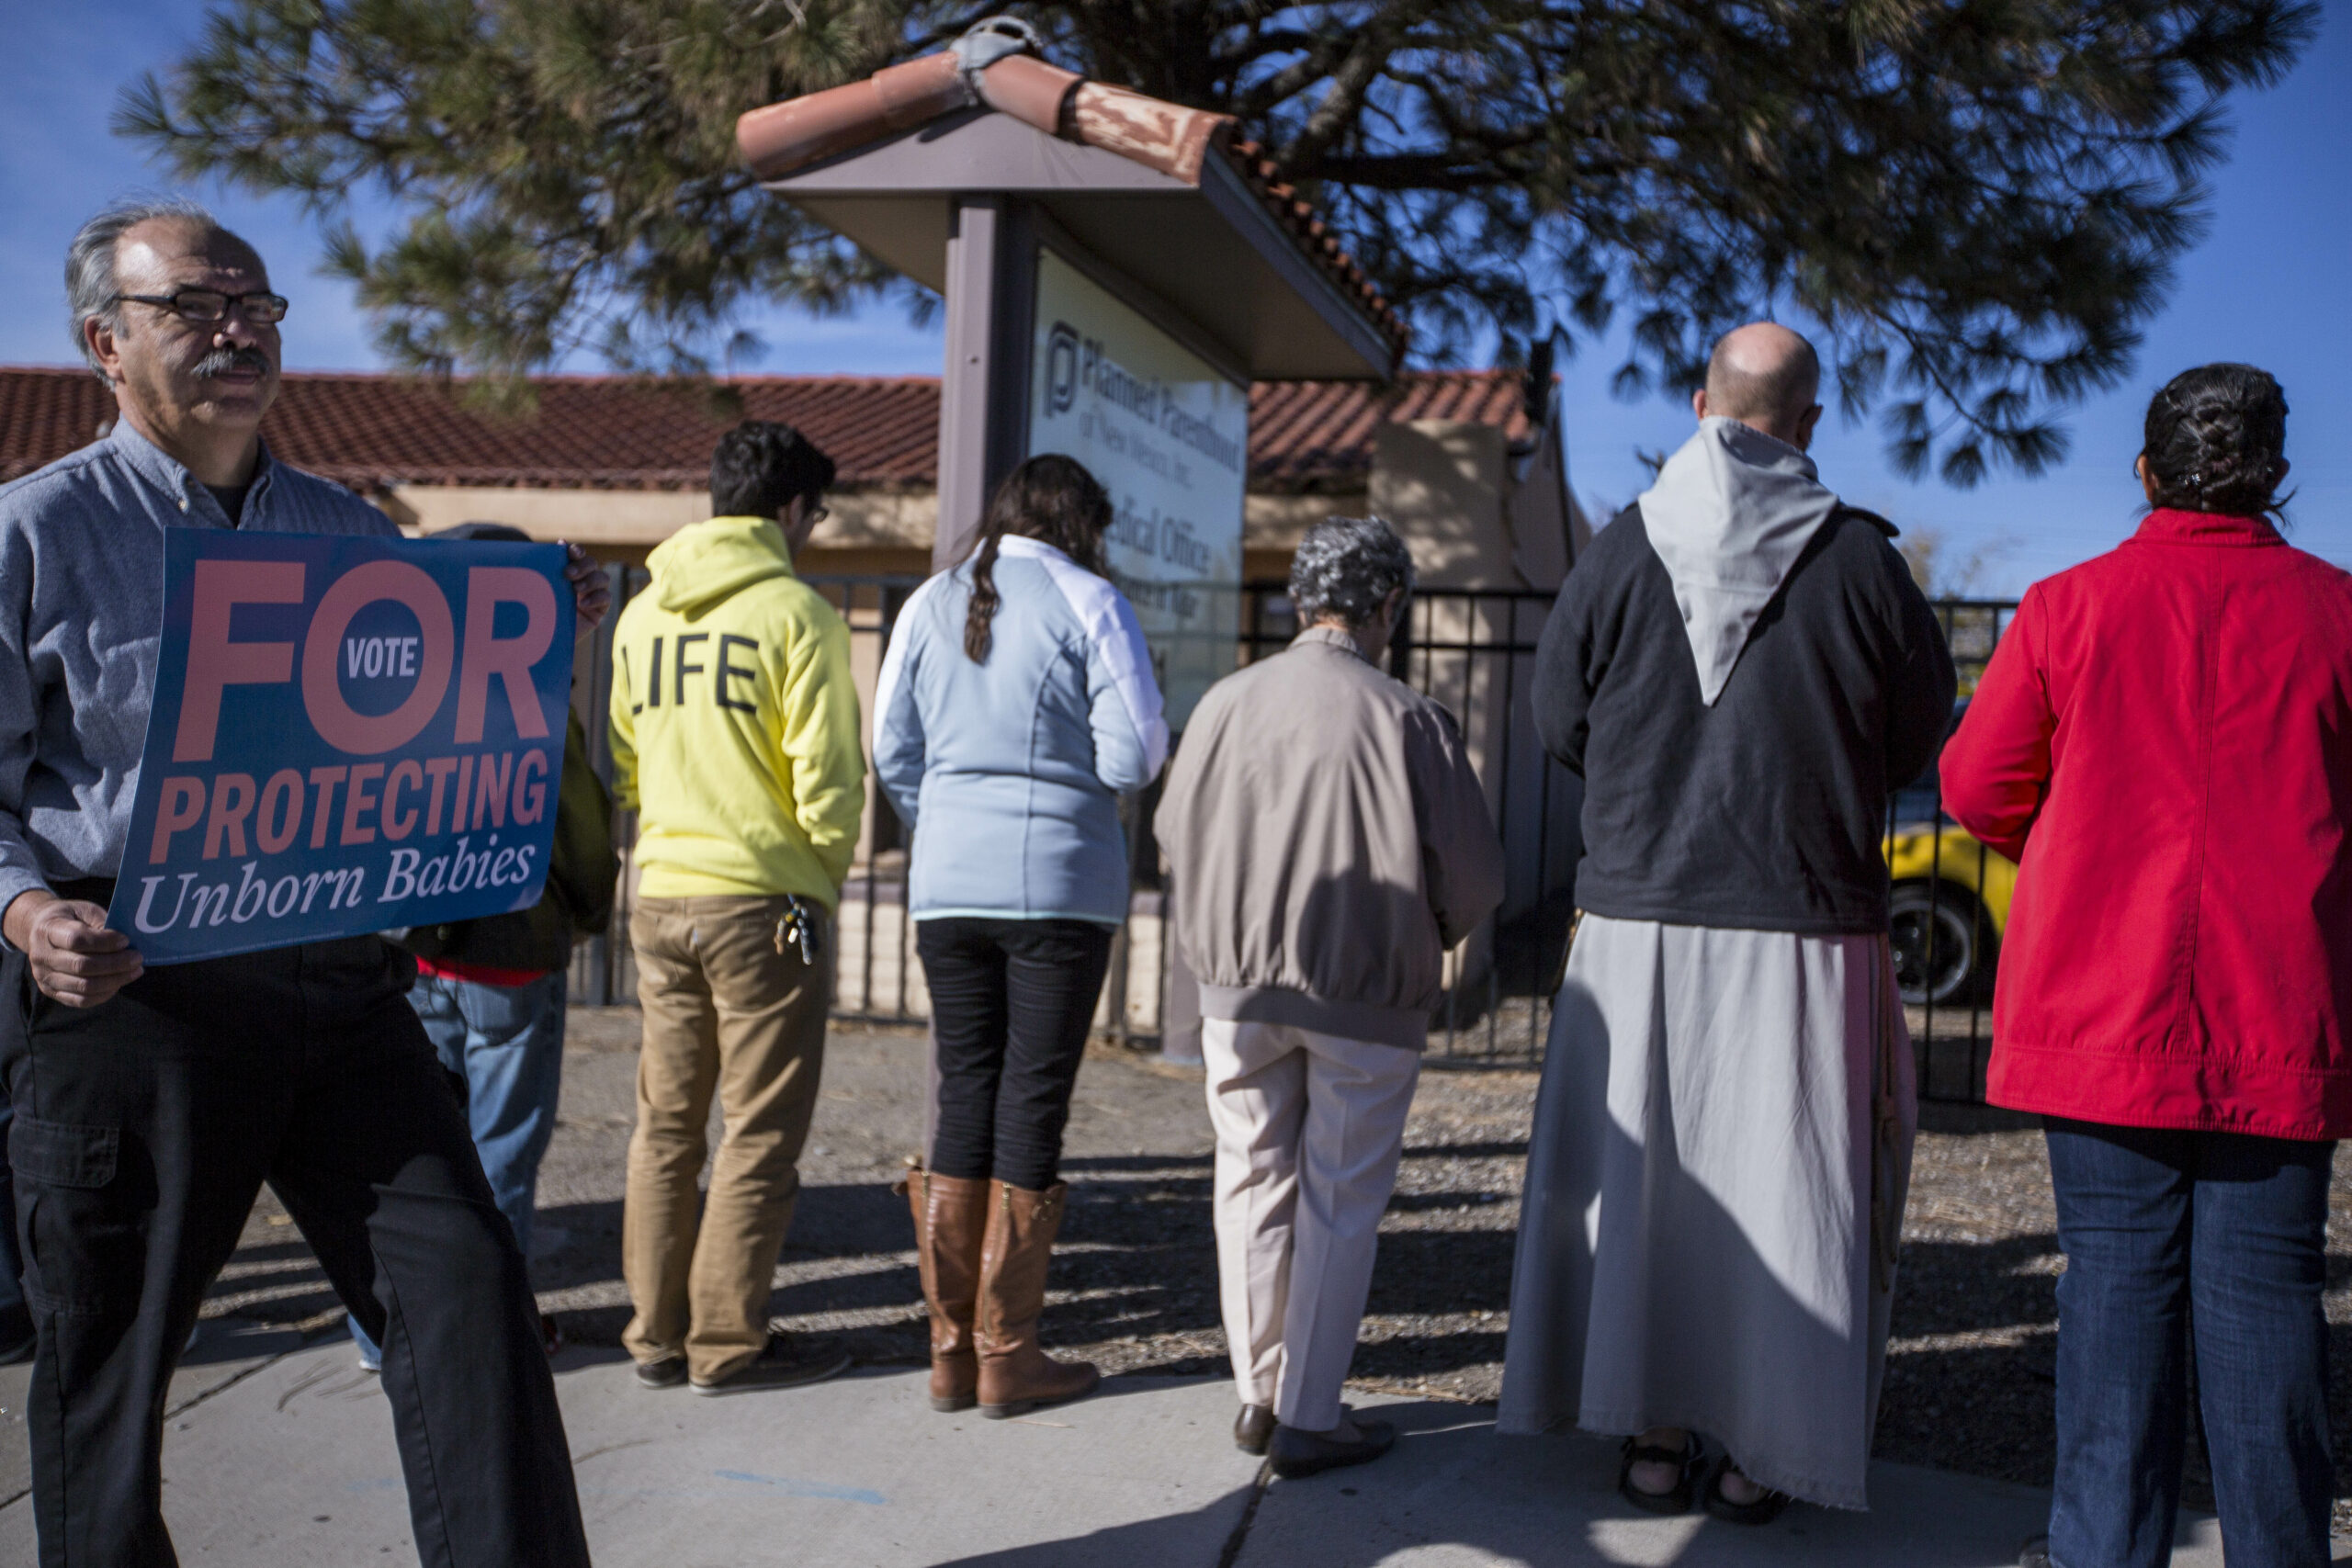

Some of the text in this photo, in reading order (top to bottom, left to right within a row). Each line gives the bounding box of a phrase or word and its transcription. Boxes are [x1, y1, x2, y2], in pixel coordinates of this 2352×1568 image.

[1081, 337, 1160, 424] Planned
[1103, 494, 1209, 575] edical Office
[172, 558, 557, 763] FOR
[346, 637, 418, 679] VOTE
[148, 749, 550, 864] PROTECTING
[134, 832, 537, 934] Unborn Babies
